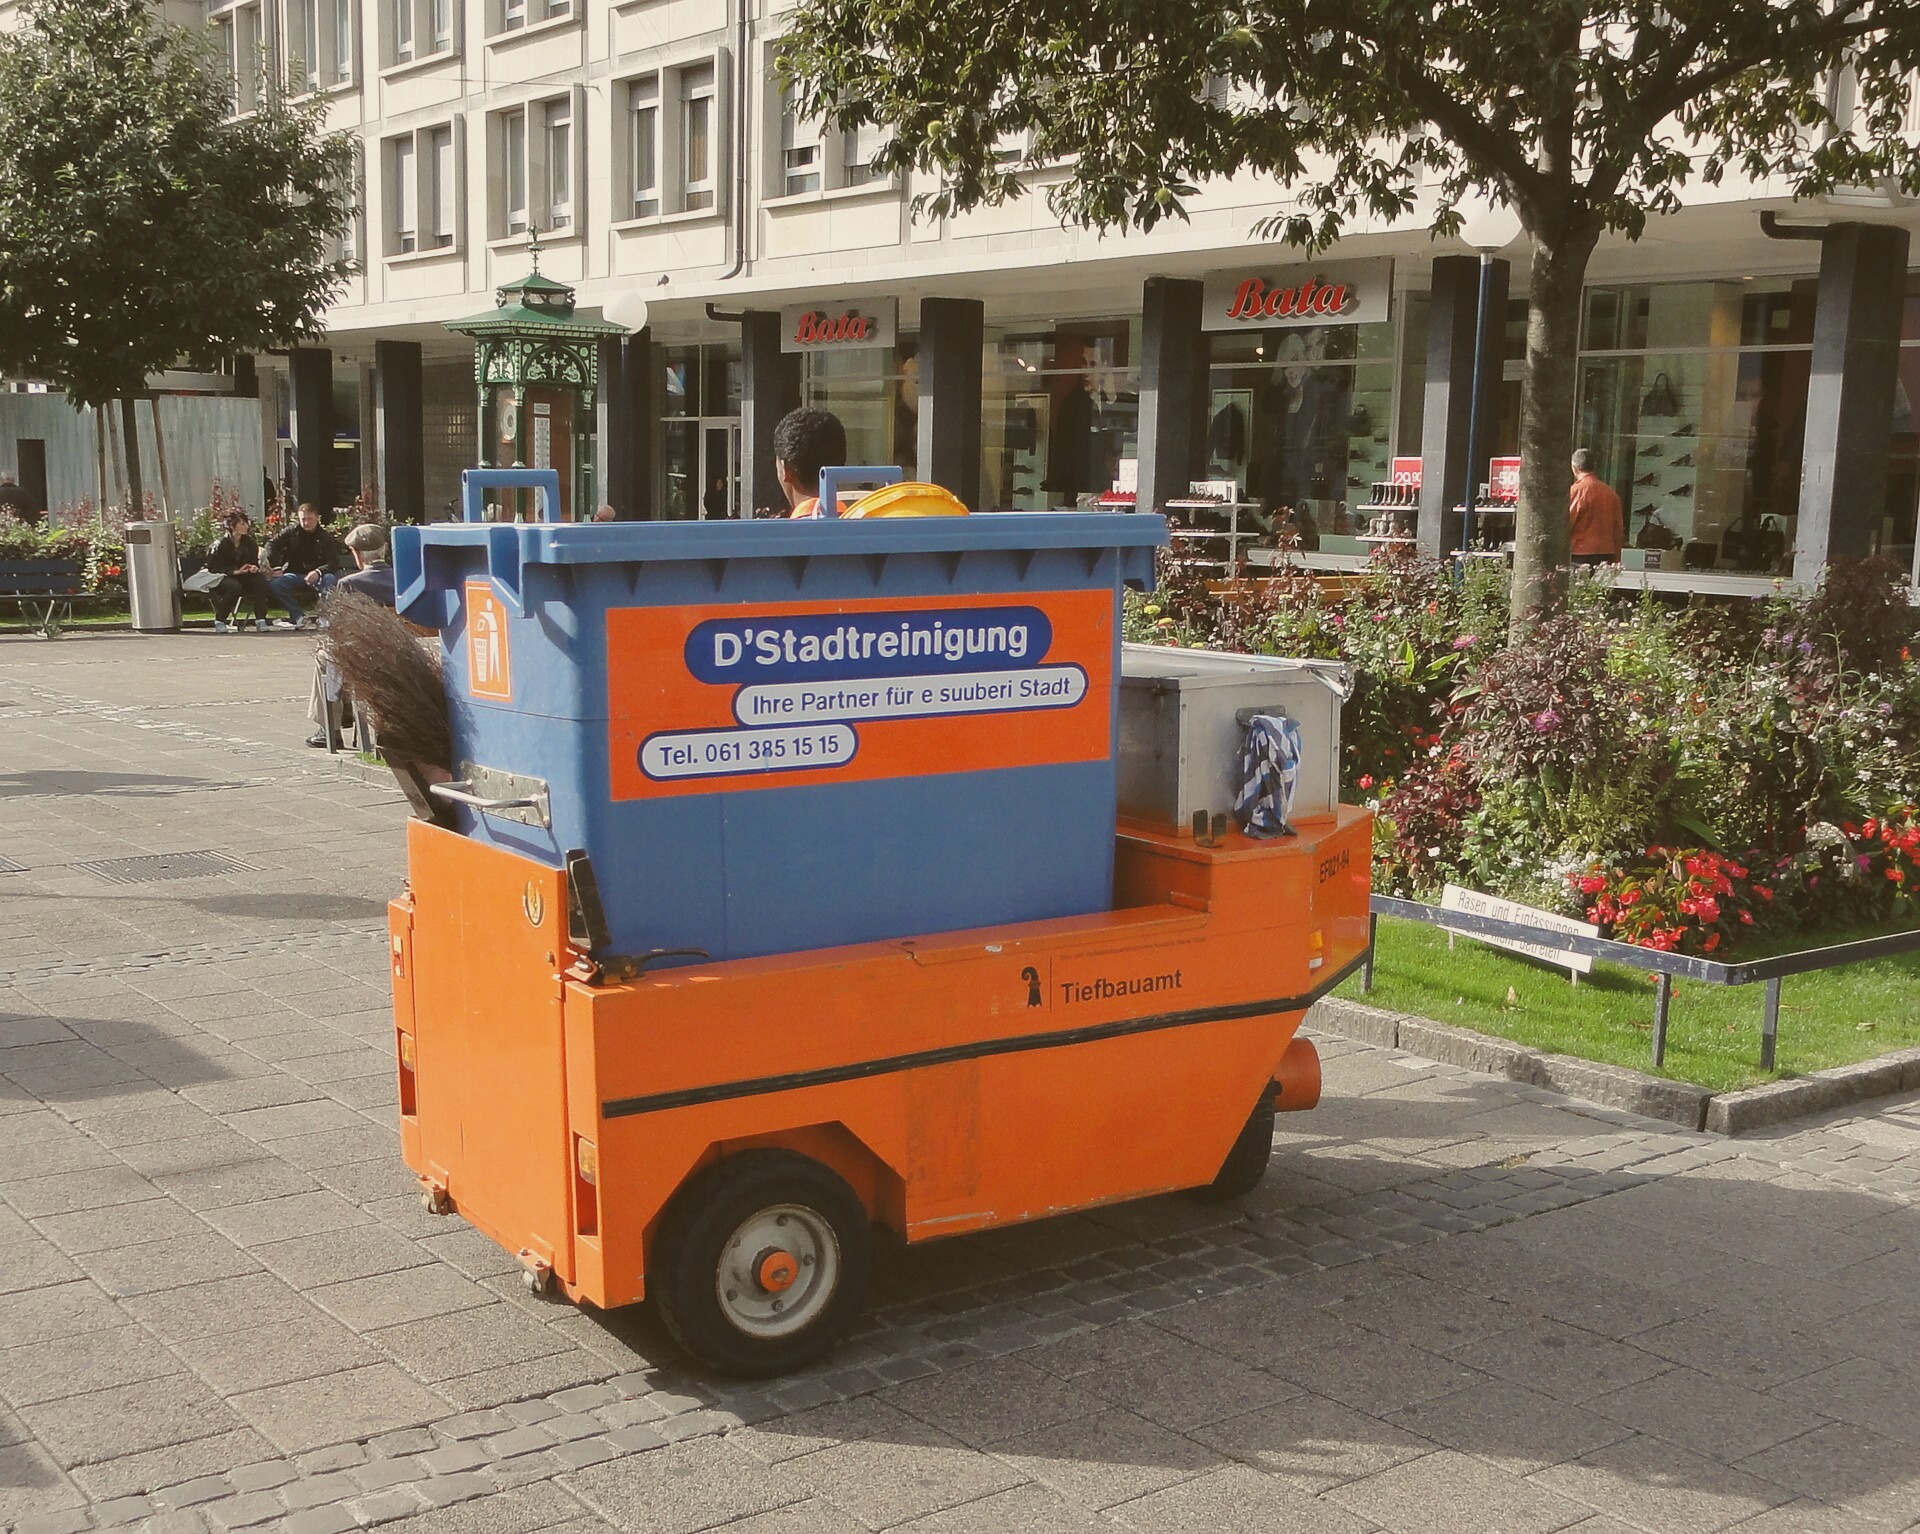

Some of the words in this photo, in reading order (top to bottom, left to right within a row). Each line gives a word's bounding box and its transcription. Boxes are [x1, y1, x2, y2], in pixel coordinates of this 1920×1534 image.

[1225, 276, 1350, 320] Bata
[793, 310, 868, 344] Bata
[1492, 470, 1520, 486] -50
[714, 620, 1028, 667] D'Stadtreinigung
[753, 695, 794, 715] Ihre
[801, 690, 879, 711] Partner
[886, 686, 914, 706] für
[921, 689, 933, 703] e
[939, 680, 1012, 703] suuberi
[1019, 677, 1070, 697] Stadt
[660, 744, 698, 766] Tel.
[705, 742, 740, 763] 061
[748, 738, 786, 760] 385
[792, 736, 813, 756] 15
[819, 735, 839, 754] 15
[1458, 891, 1487, 914] Rasen
[1492, 905, 1509, 921] und
[1061, 968, 1182, 1004] Tiefbauamt
